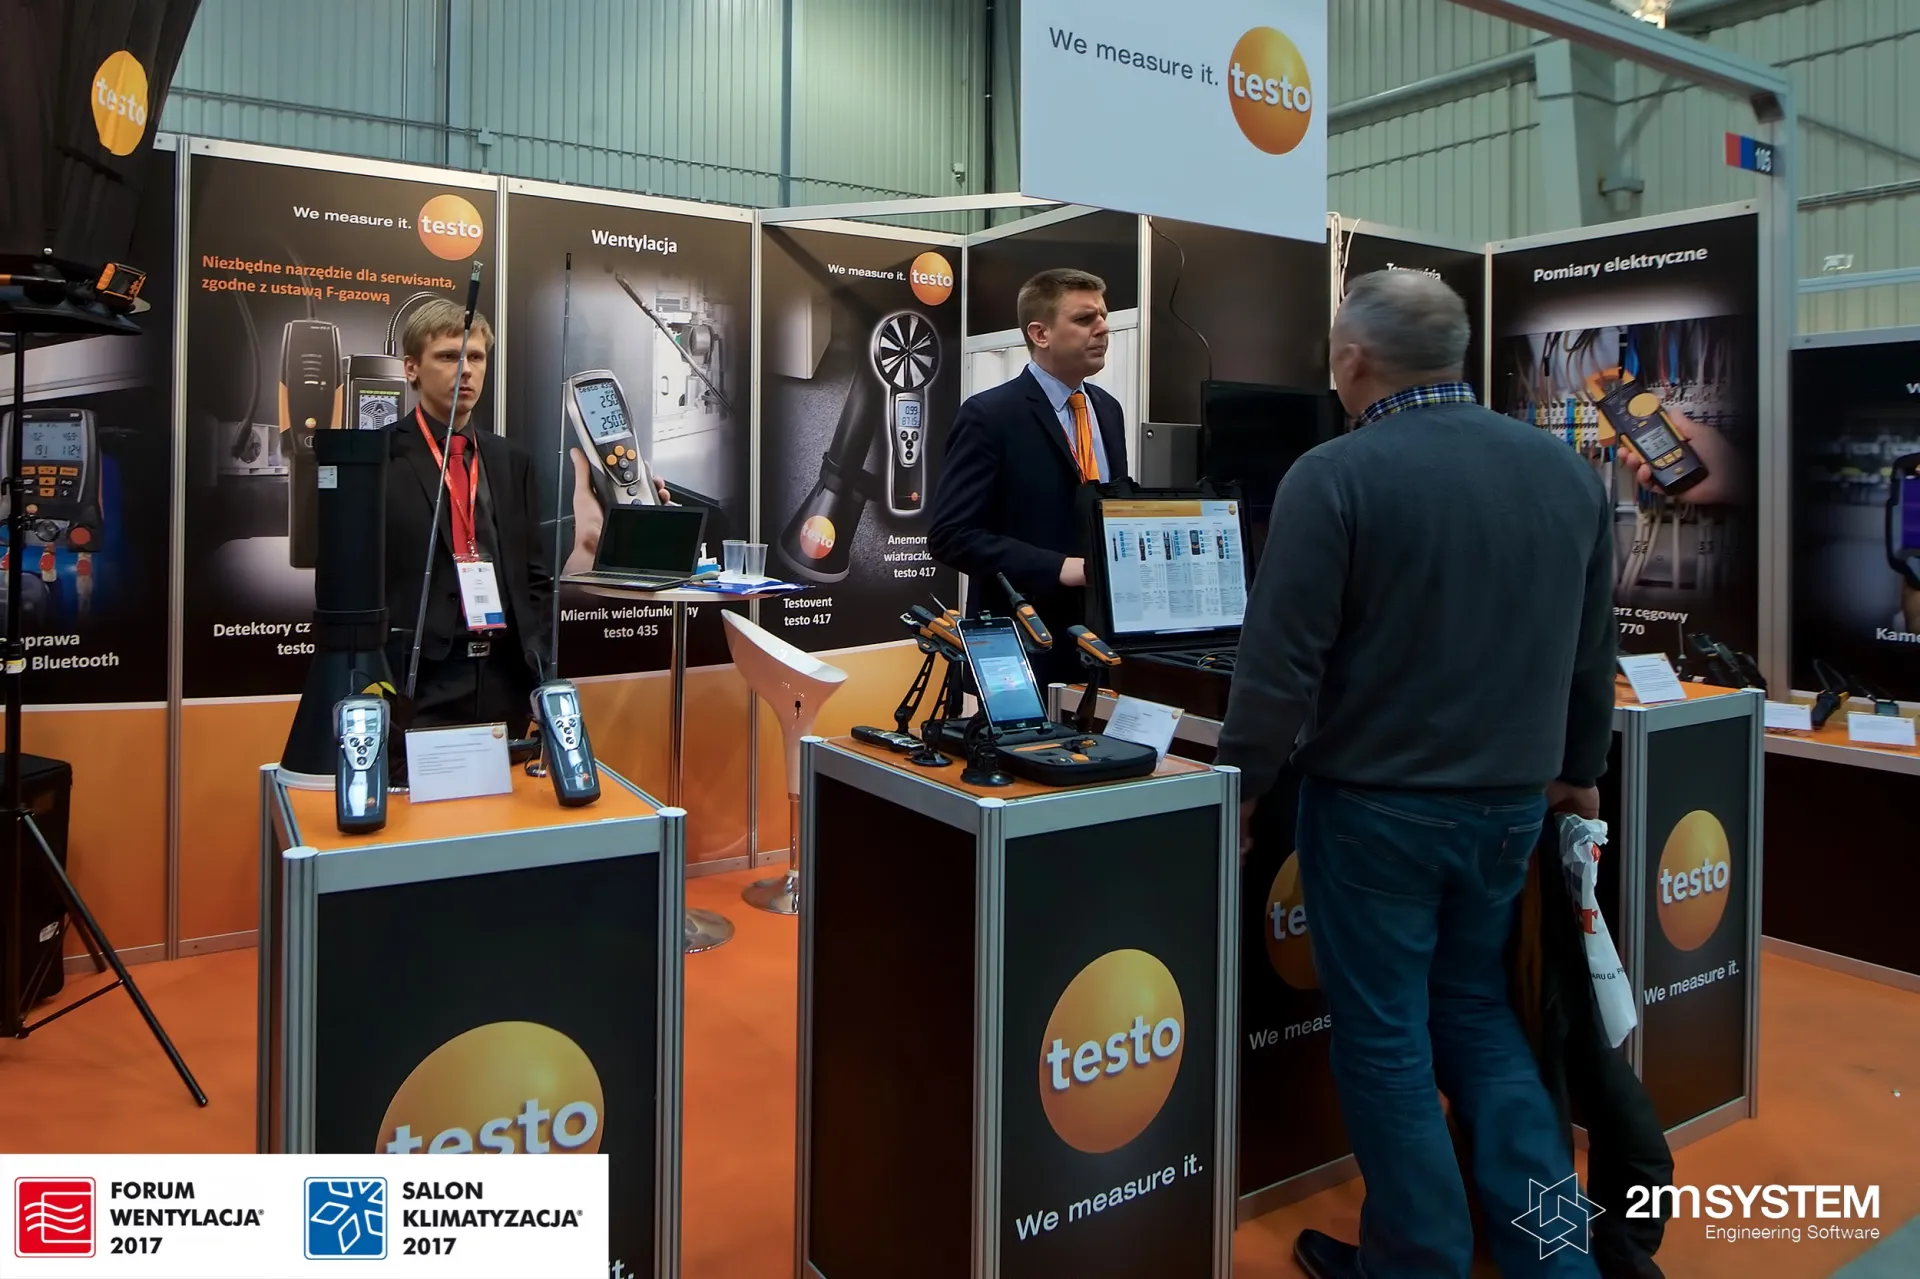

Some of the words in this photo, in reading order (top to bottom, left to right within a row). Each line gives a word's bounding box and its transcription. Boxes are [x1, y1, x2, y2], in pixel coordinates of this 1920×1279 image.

[1049, 27, 1087, 54] We
[1096, 40, 1193, 79] measure
[1201, 64, 1219, 85] it.
[1230, 62, 1311, 113] testo
[96, 77, 145, 126] testo
[293, 205, 320, 219] We
[324, 210, 394, 228] measure
[398, 217, 412, 229] it.
[421, 215, 482, 239] testo
[591, 229, 678, 256] Wentylacja
[202, 255, 282, 275] Niezbędne
[285, 264, 353, 281] narzędzie
[356, 268, 377, 283] dla
[380, 272, 457, 291] serwisanta,
[827, 263, 846, 275] We
[848, 267, 894, 280] measure
[896, 271, 907, 281] it.
[1533, 262, 1600, 282] Pomiary
[1604, 247, 1708, 273] elektryczne
[912, 269, 953, 288] testo
[201, 277, 256, 293] zgodne
[259, 282, 267, 294] z
[271, 282, 322, 300] ustawą
[326, 285, 391, 305] F-gazową
[893, 568, 918, 578] testo
[919, 566, 936, 577] 417
[560, 607, 609, 621] Miernik
[783, 597, 833, 609] Testovent
[784, 615, 811, 626] testo
[812, 613, 831, 625] 417
[1634, 608, 1689, 624] cęgowy
[213, 621, 292, 637] Detektory
[604, 627, 634, 639] testo
[636, 624, 659, 637] 435
[1619, 622, 1645, 635] 770
[32, 651, 120, 670] Bluetooth
[277, 642, 316, 655] testo
[1660, 857, 1730, 905] testo
[1644, 985, 1666, 1006] We
[1669, 966, 1726, 999] measure
[1728, 959, 1740, 976] it.
[1248, 1026, 1280, 1051] We
[1046, 1015, 1182, 1092] testo
[1015, 1208, 1060, 1241] We
[1068, 1164, 1176, 1224] measure
[1184, 1153, 1204, 1177] it.
